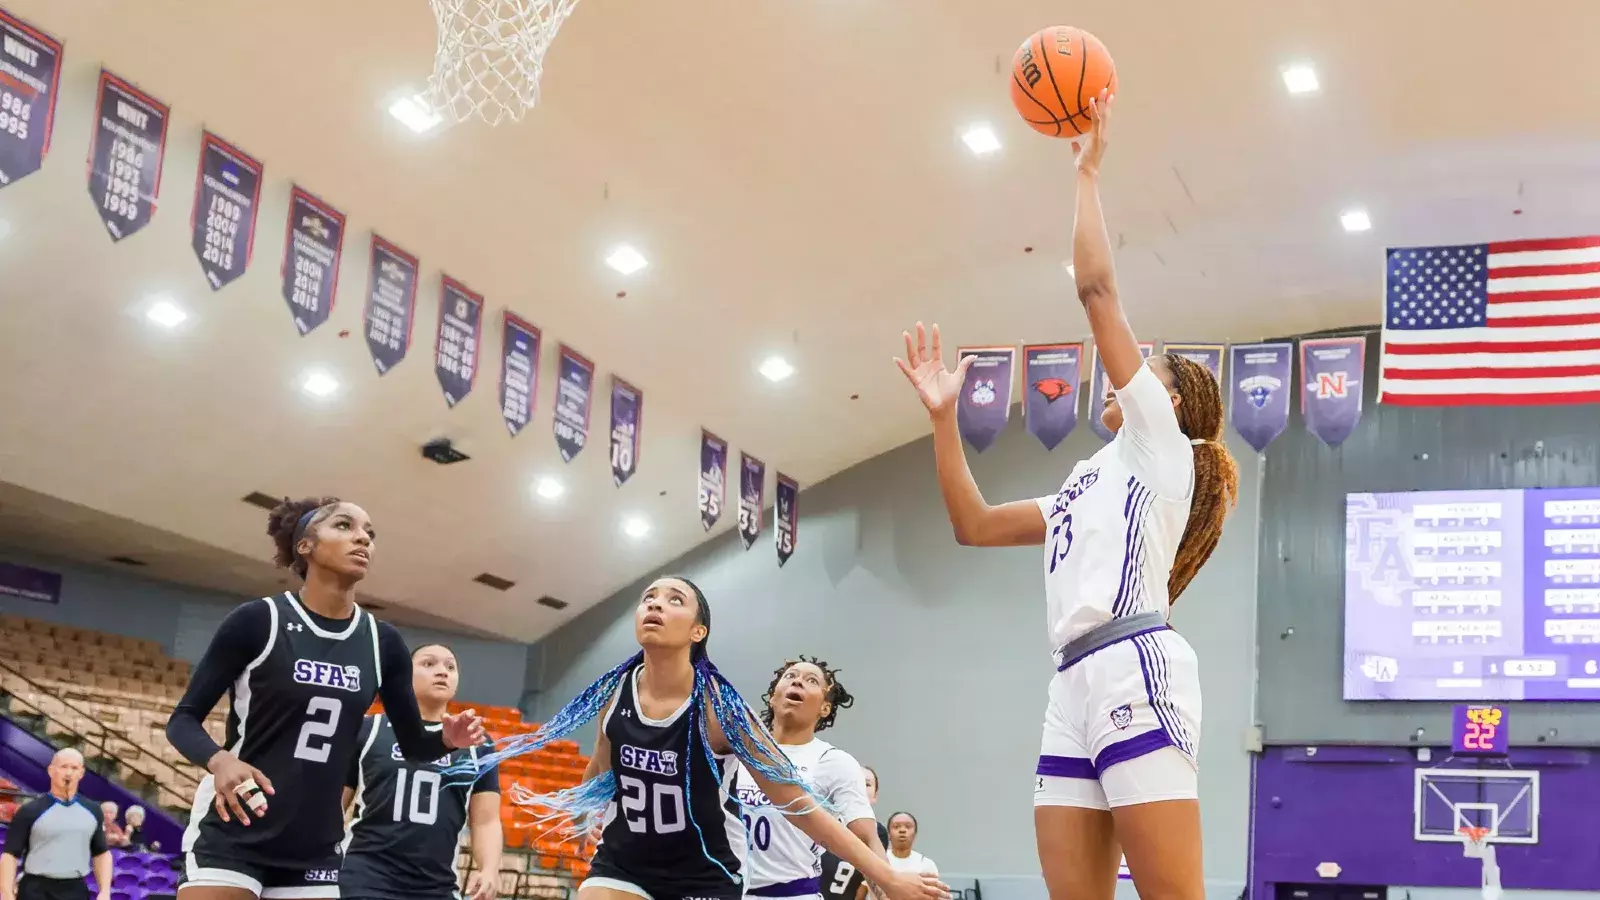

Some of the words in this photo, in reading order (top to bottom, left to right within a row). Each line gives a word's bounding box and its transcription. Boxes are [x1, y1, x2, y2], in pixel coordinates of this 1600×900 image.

[612, 442, 632, 472] 10
[699, 491, 719, 516] 25
[739, 509, 758, 535] 33
[293, 658, 346, 690] SFA
[293, 695, 342, 763] 2
[1466, 708, 1502, 726] 4:52
[1463, 723, 1495, 749] 22
[620, 744, 664, 776] SFA
[393, 767, 442, 826] 10
[620, 774, 686, 835] 20
[829, 860, 856, 895] 9
